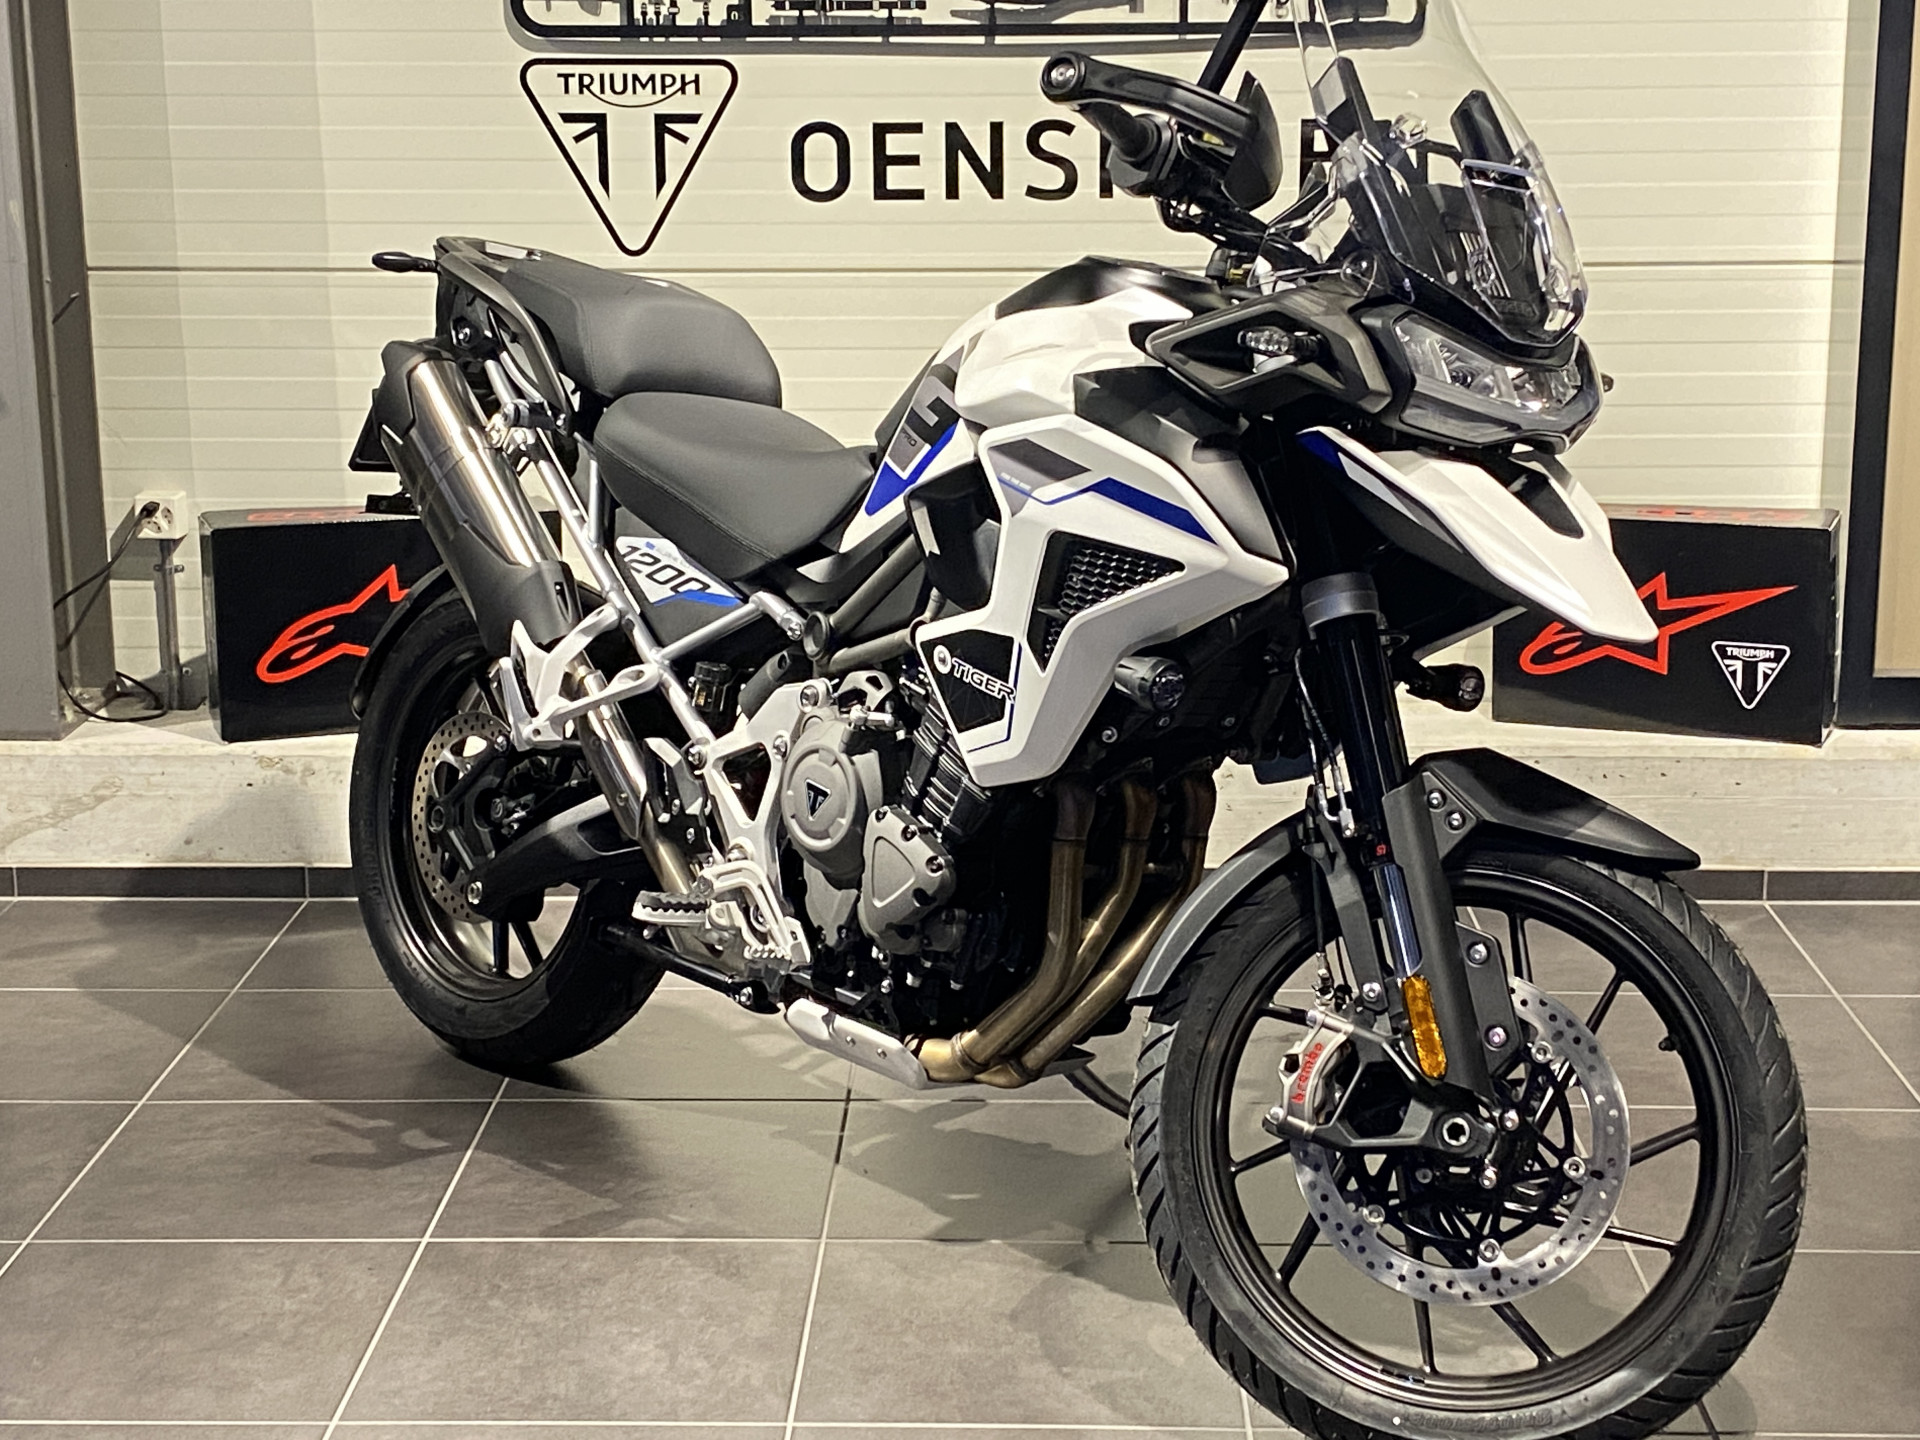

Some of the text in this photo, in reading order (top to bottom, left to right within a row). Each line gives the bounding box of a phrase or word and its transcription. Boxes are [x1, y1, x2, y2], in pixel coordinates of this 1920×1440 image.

[557, 73, 702, 104] TRIUMPH
[622, 545, 711, 593] 1200
[1725, 647, 1775, 660] TRIUMPH
[952, 658, 1016, 704] TIGER
[1291, 1043, 1324, 1103] brembo
